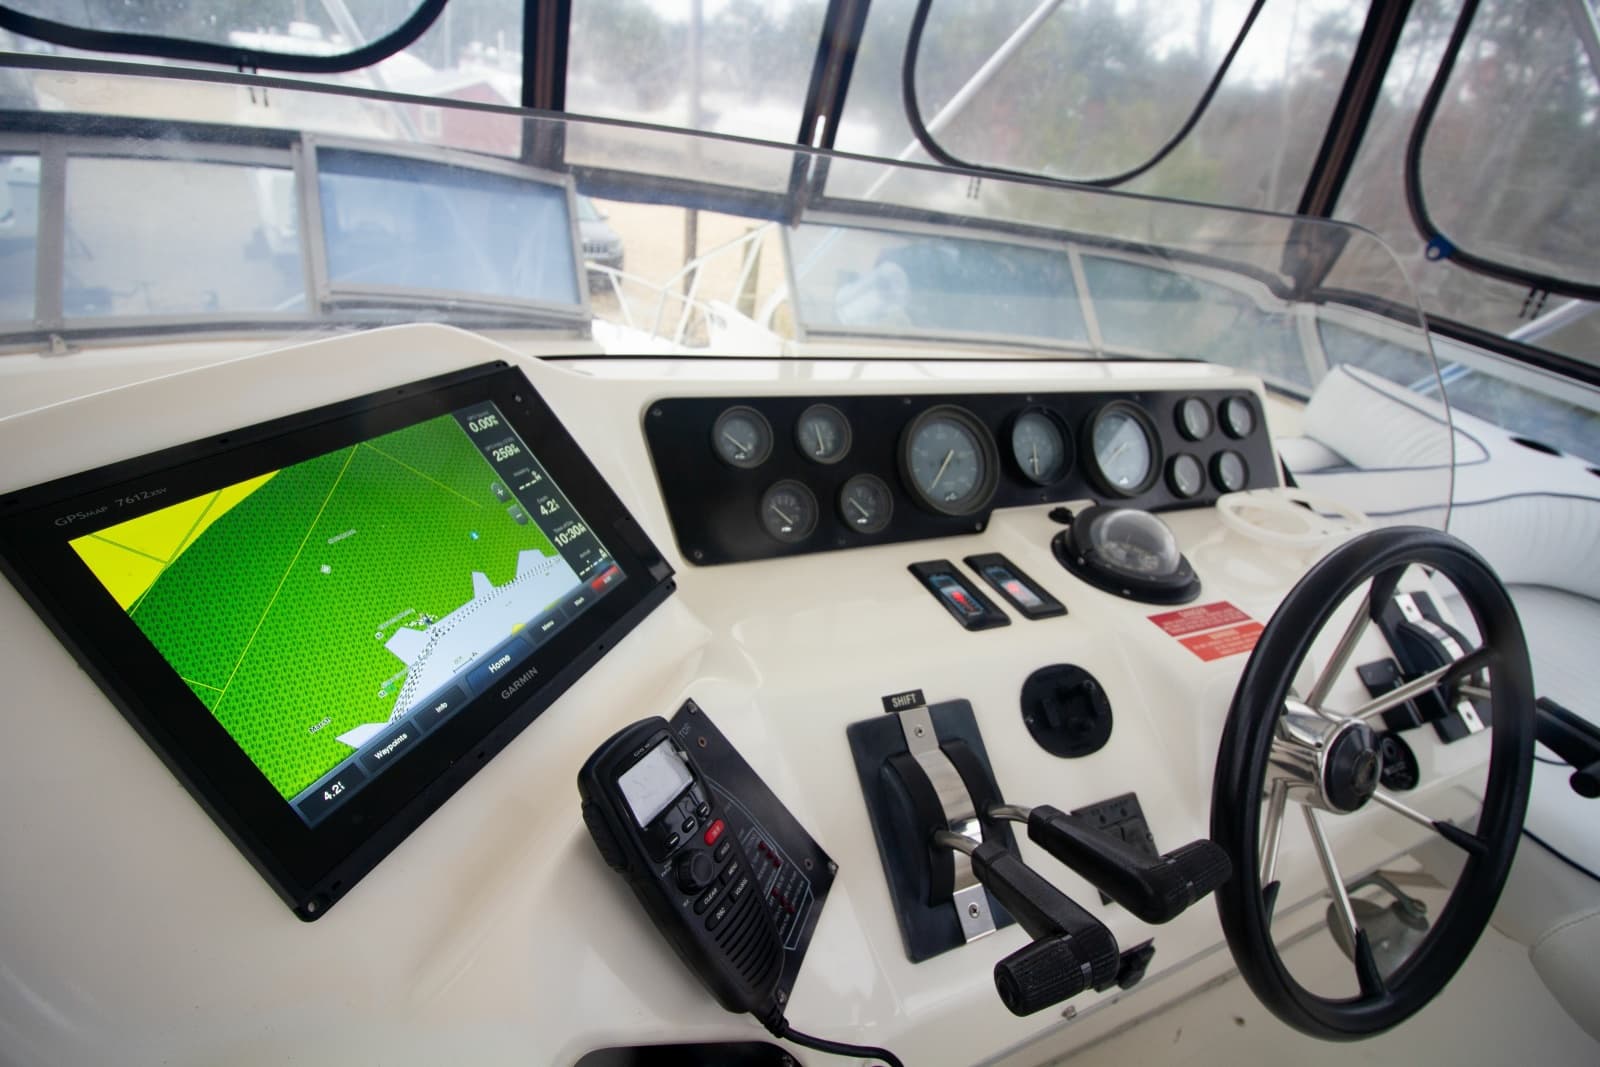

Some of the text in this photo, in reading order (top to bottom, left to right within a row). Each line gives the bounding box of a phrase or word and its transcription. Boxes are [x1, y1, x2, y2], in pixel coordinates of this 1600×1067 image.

[488, 654, 511, 674] Home
[501, 666, 539, 700] GARMIN
[891, 693, 917, 708] SHIFT
[373, 732, 408, 760] Waypoints
[703, 887, 718, 905] CLEAR
